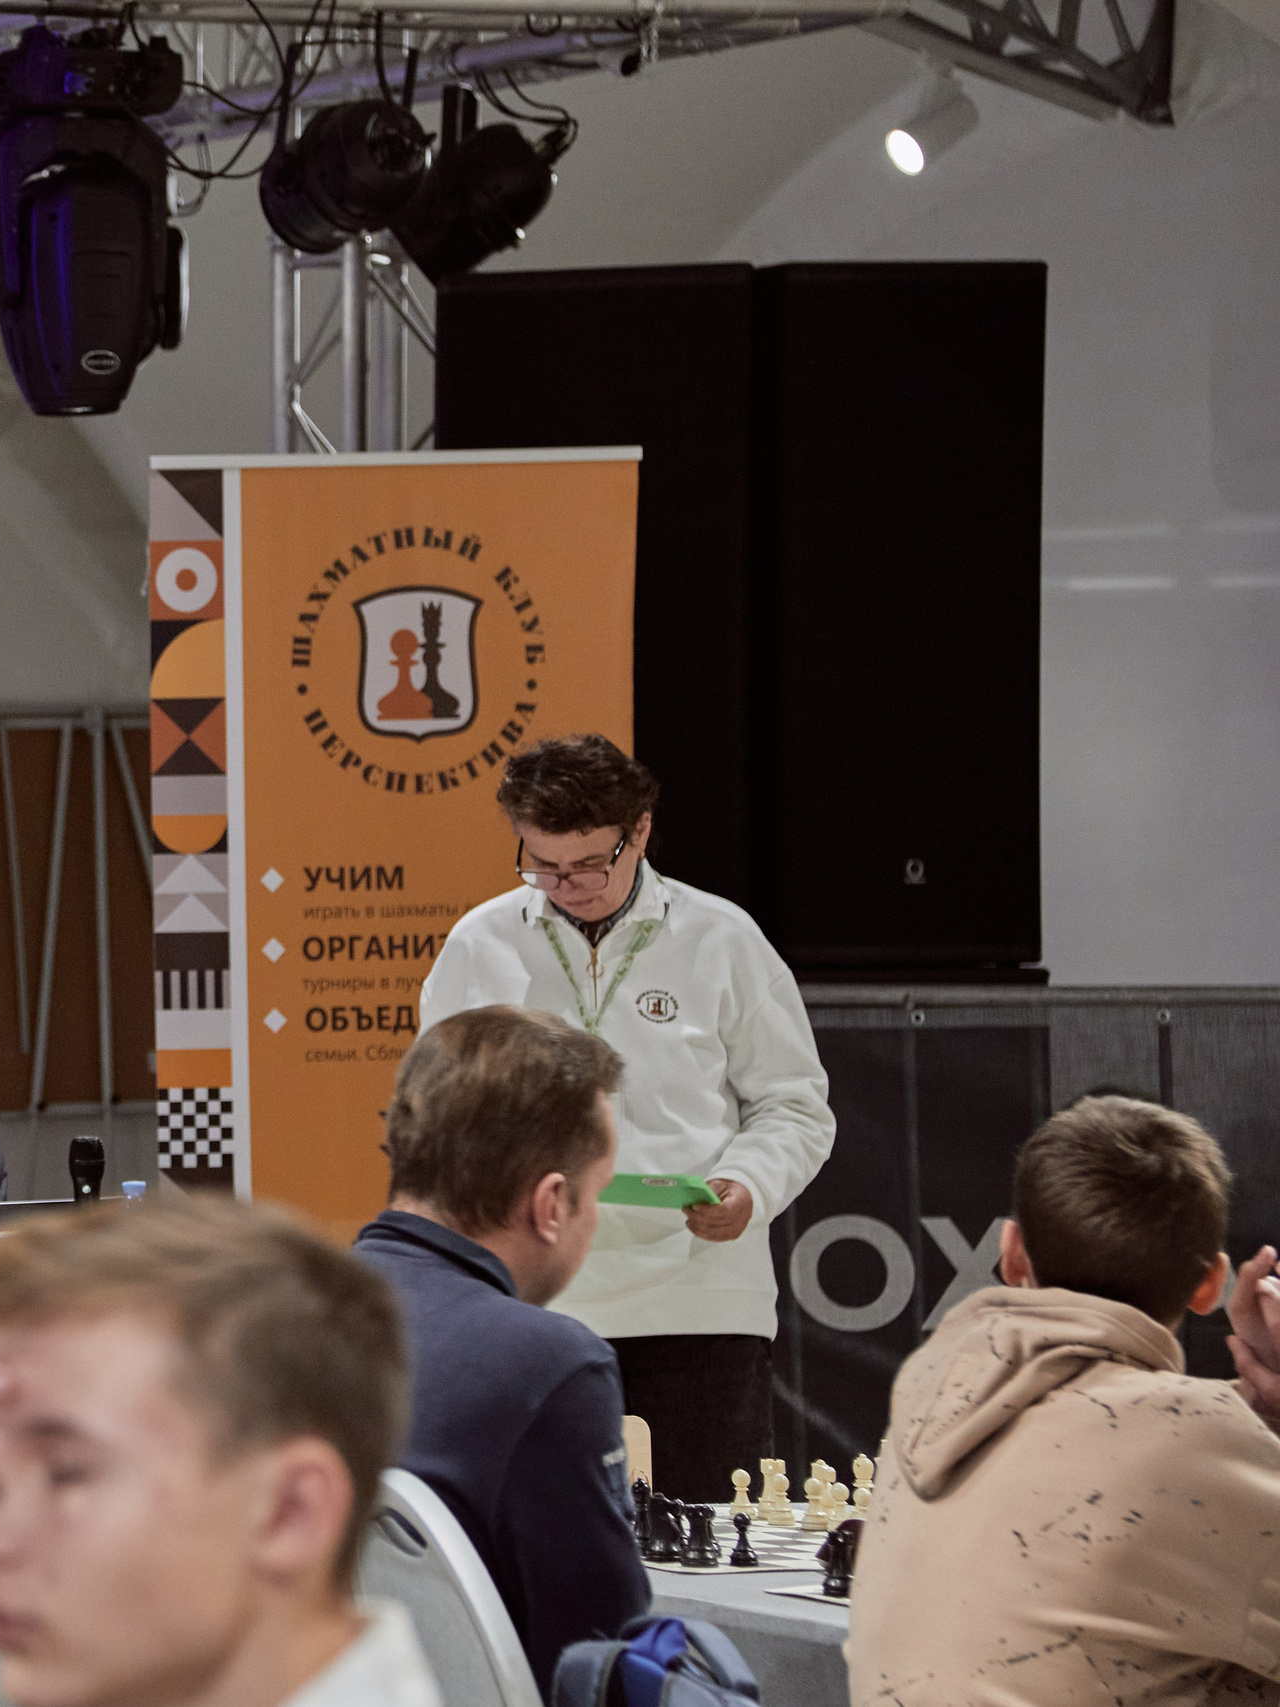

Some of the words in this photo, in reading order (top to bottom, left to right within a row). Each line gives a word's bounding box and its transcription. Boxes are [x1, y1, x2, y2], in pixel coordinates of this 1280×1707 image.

[291, 526, 483, 668] ШАХМАТНЫЙ
[493, 566, 546, 666] КЛУБ
[302, 702, 537, 794] ПЕРСПЕКТИВА
[304, 865, 405, 892] УЧИМ
[303, 905, 360, 922] играть
[365, 906, 375, 919] в
[380, 904, 458, 919] шахматы
[302, 934, 447, 962] ОРГАНИ
[302, 977, 375, 994] турниры
[380, 977, 390, 990] в
[305, 1005, 417, 1035] ОБЪЕД
